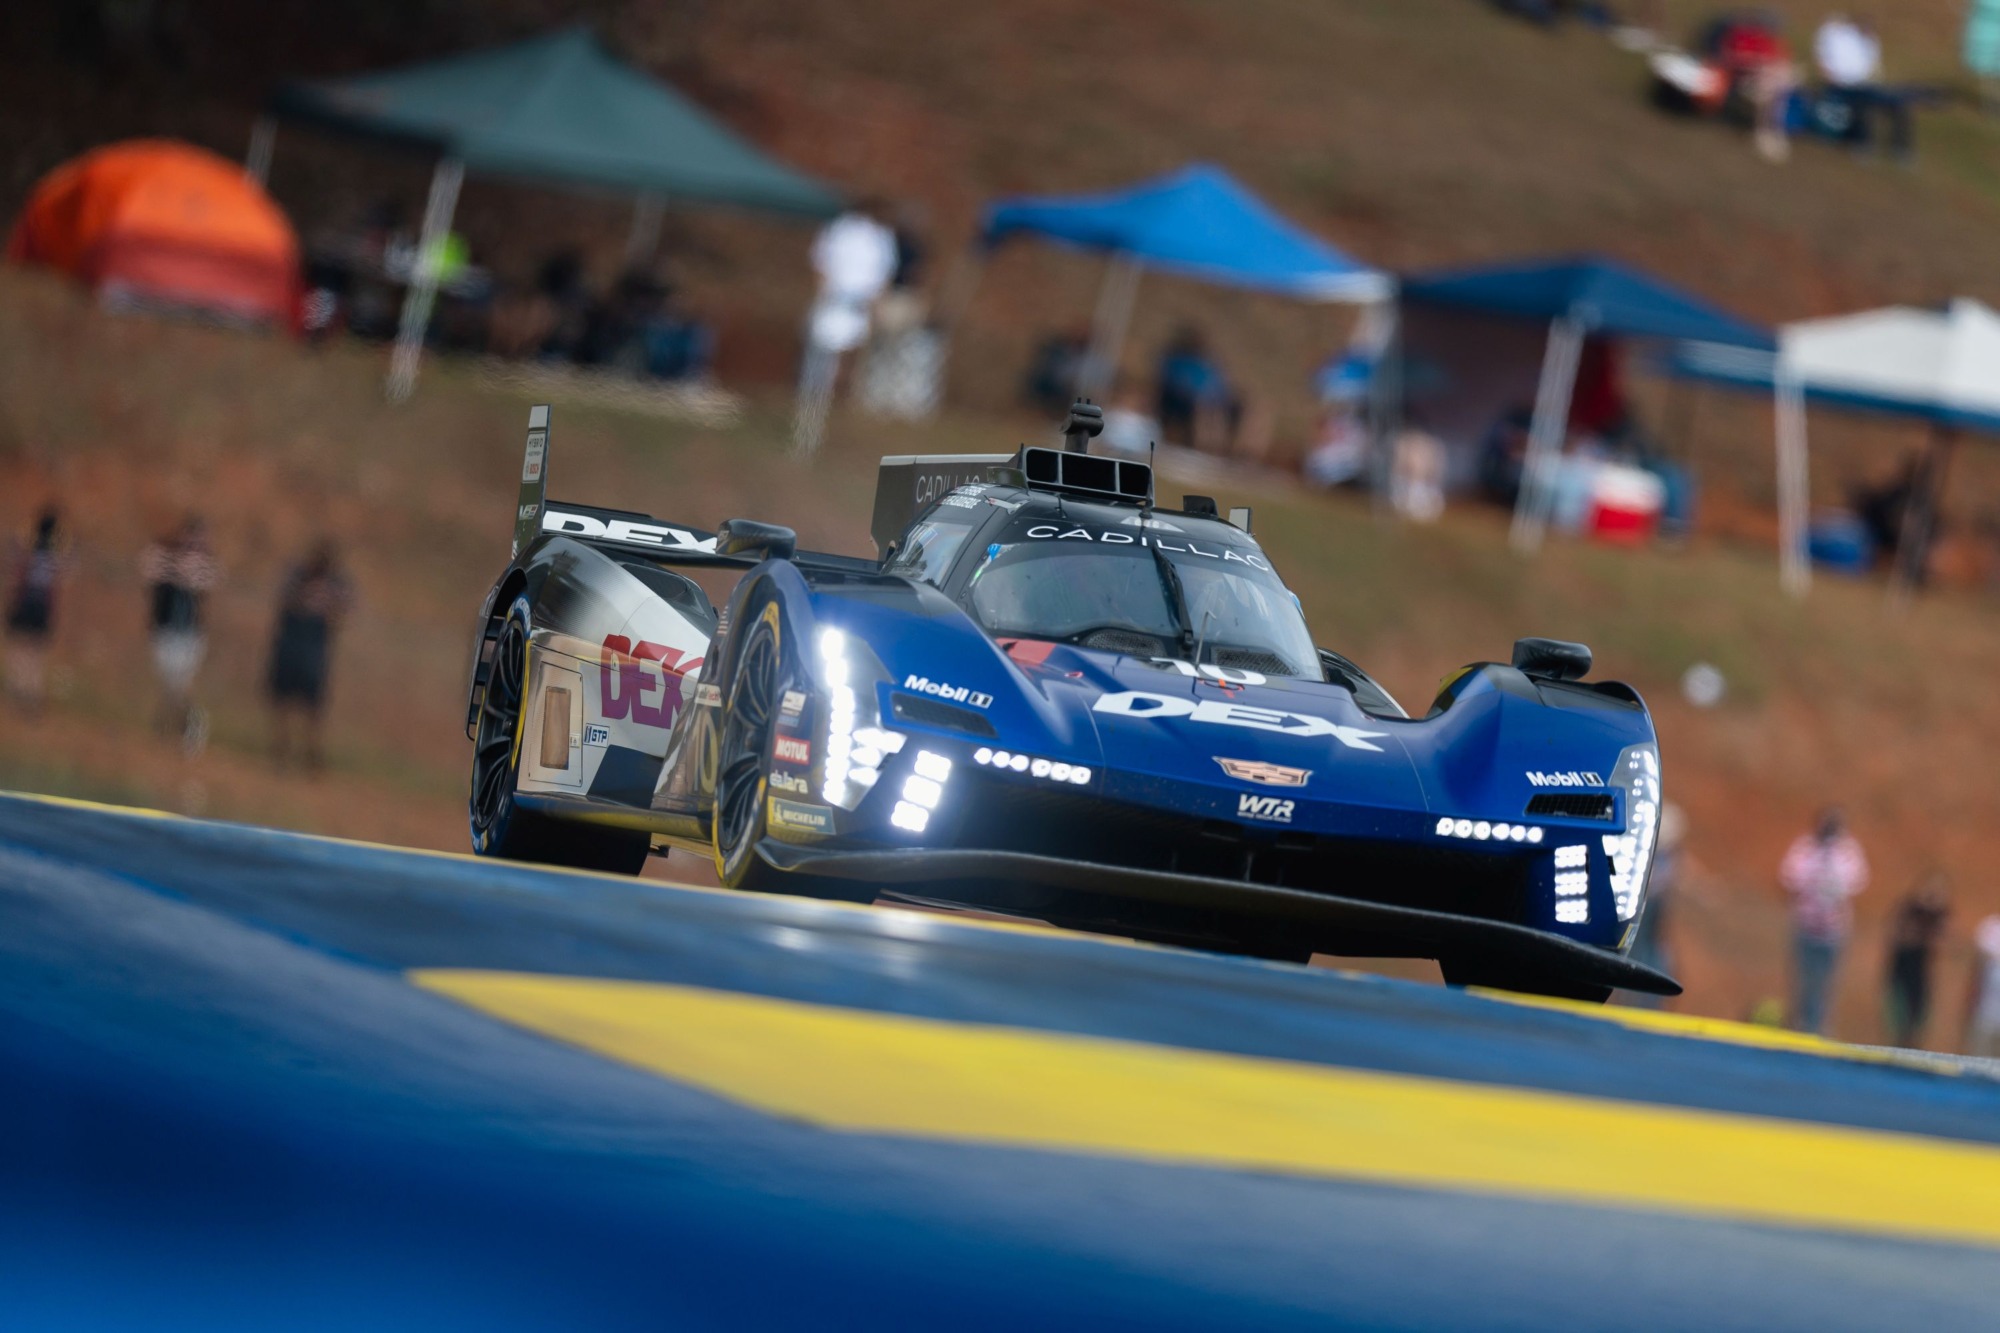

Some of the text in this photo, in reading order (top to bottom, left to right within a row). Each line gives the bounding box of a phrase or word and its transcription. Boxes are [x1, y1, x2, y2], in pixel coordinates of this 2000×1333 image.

[916, 475, 981, 503] CADI
[542, 510, 718, 555] DEX
[1026, 525, 1269, 572] CADILLAC
[904, 674, 969, 702] Mobil
[1092, 691, 1390, 752] DEX
[591, 728, 608, 744] GTP
[775, 738, 808, 761] MOTUL
[1525, 771, 1584, 786] Mobil
[1239, 794, 1295, 817] WTR
